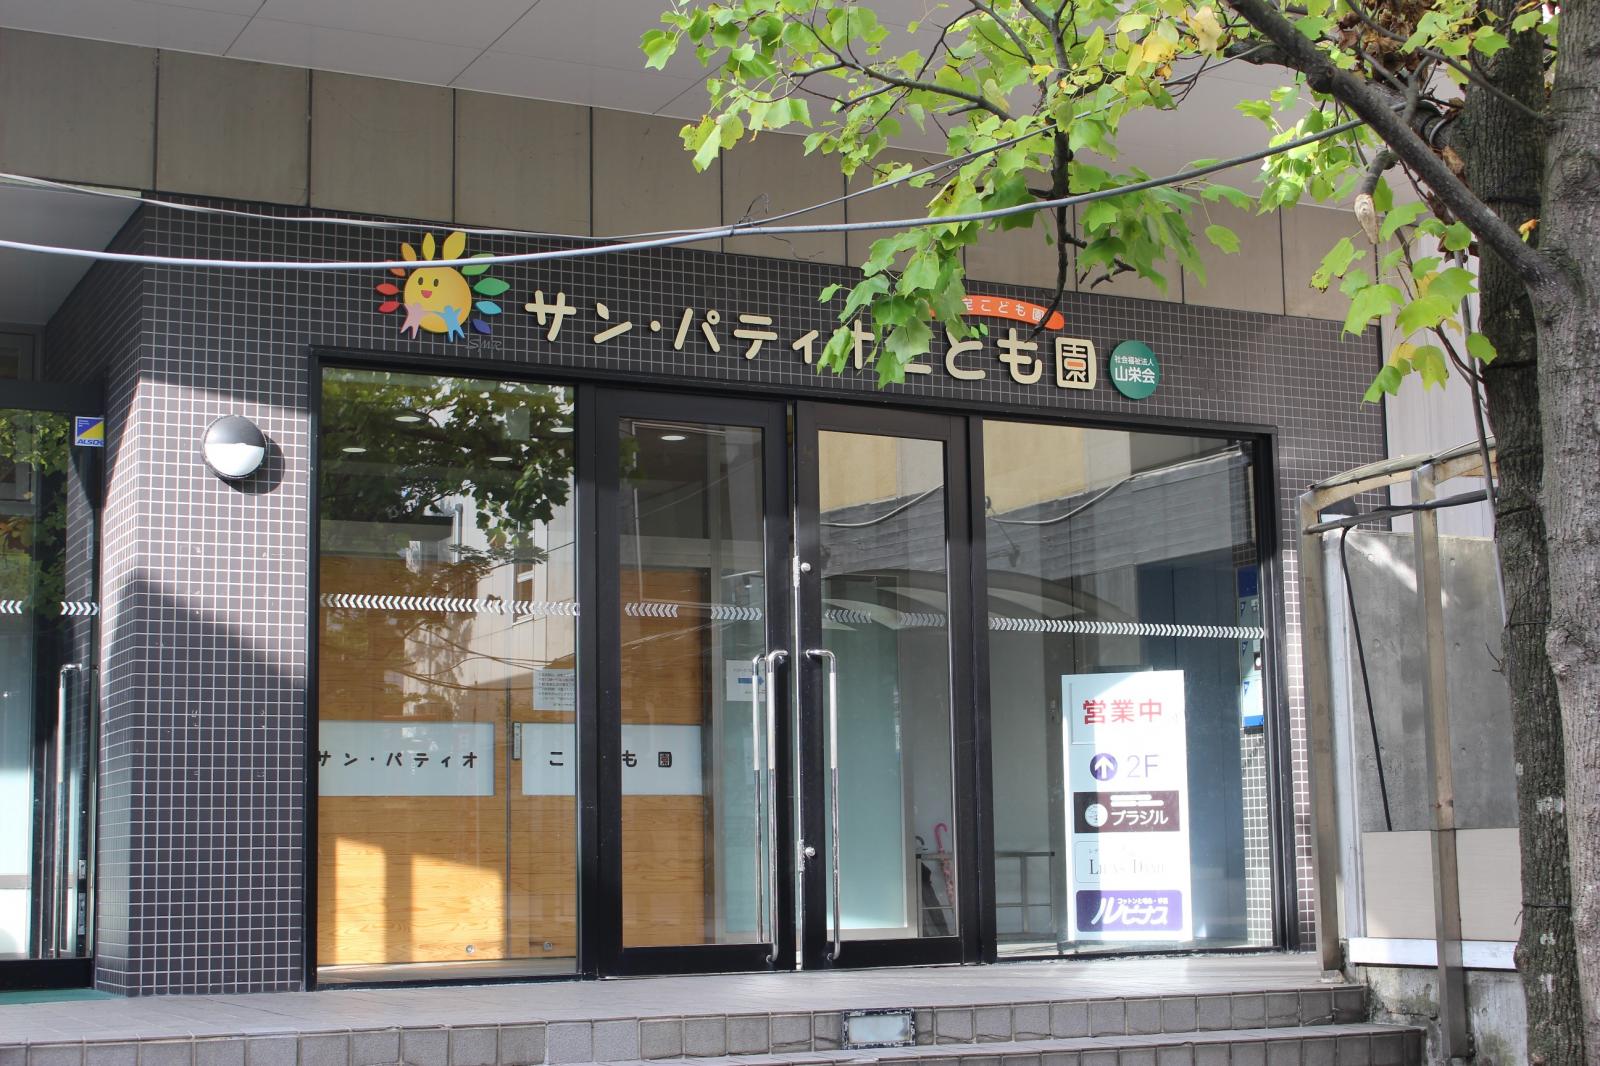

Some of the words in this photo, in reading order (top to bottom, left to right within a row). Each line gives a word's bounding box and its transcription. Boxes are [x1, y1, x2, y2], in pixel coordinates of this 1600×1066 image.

[1114, 355, 1154, 367] 社会福祉法人
[1115, 365, 1156, 384] 山栄会
[1083, 698, 1162, 724] 営業中
[1127, 754, 1160, 778] 2F
